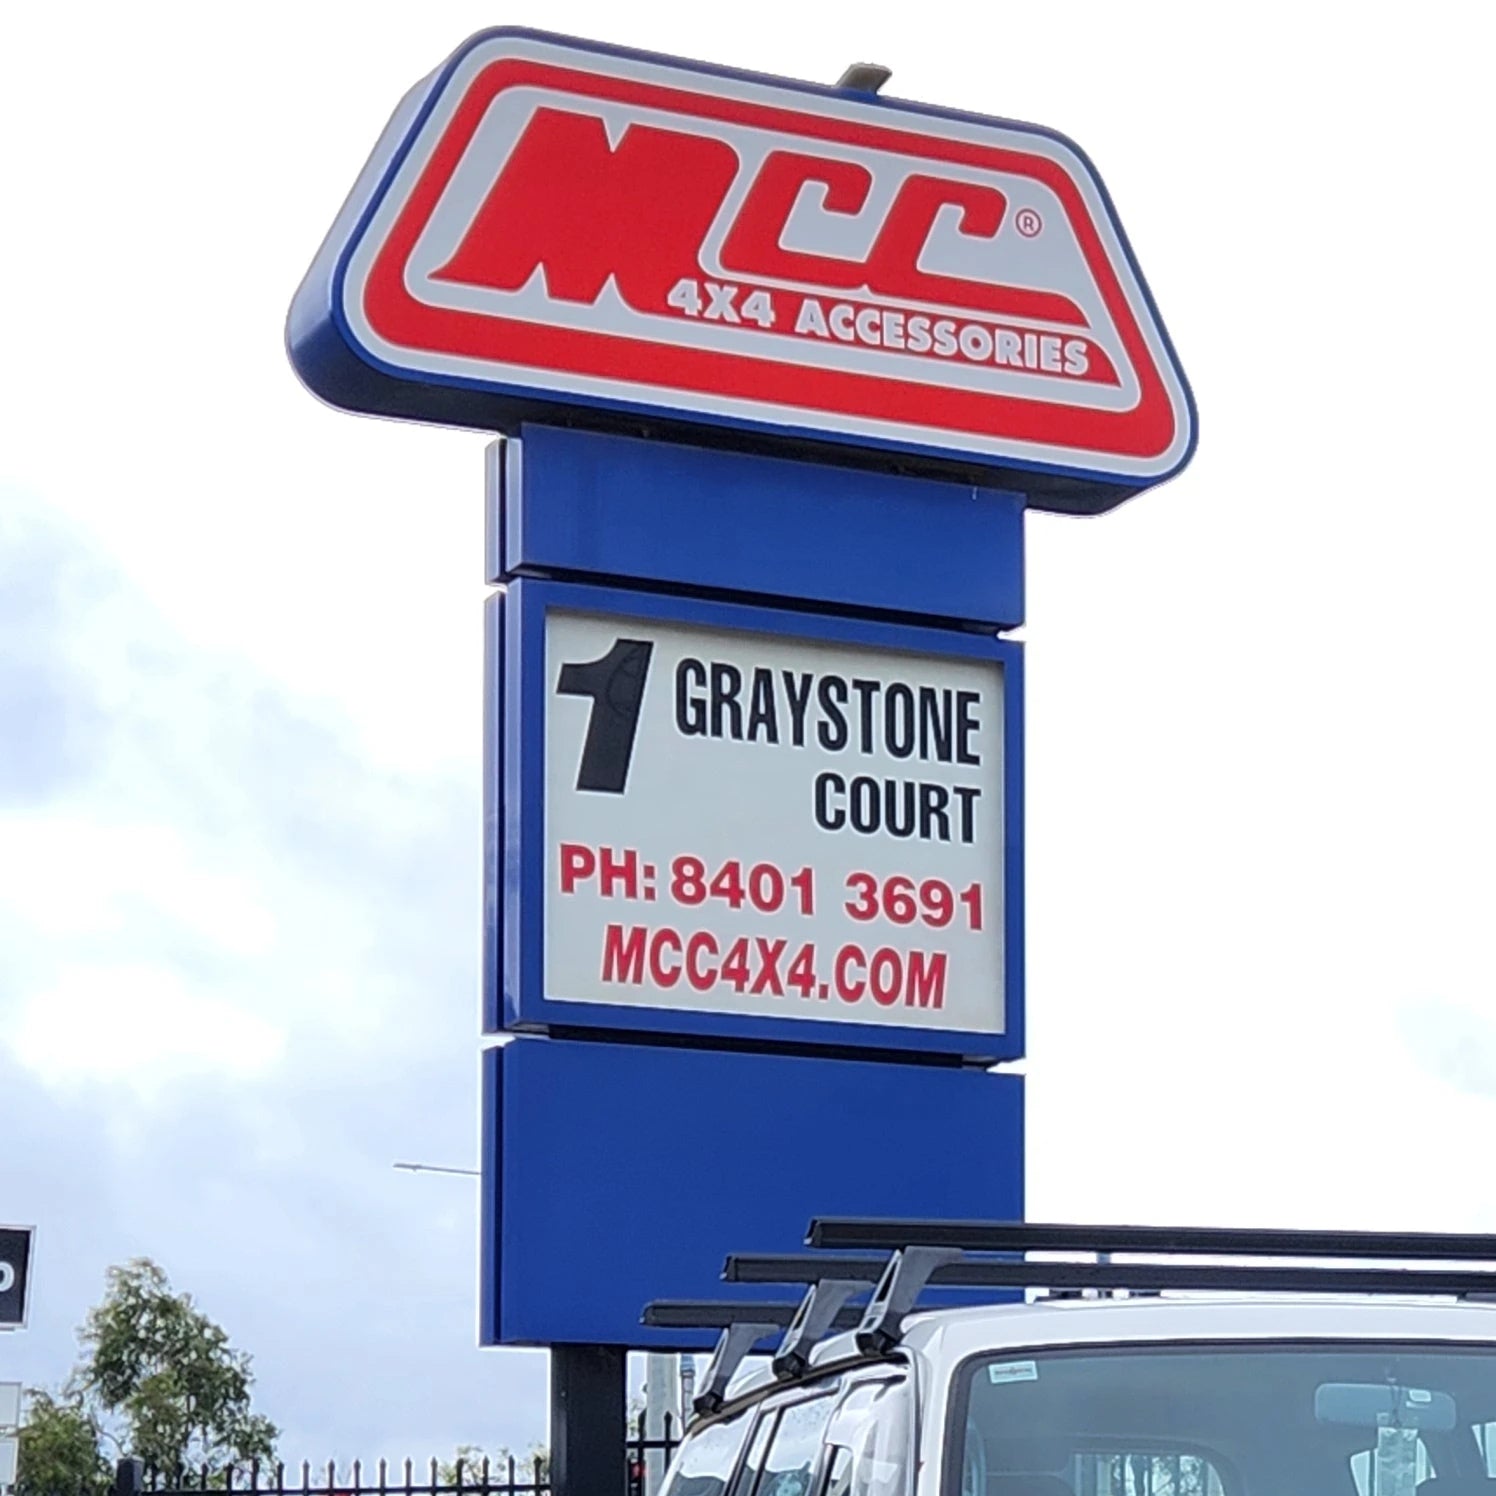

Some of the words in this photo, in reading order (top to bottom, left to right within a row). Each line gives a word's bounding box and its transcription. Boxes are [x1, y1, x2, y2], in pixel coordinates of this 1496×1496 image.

[427, 106, 1090, 328] MCC
[667, 279, 776, 329] 4X4
[796, 300, 1090, 377] ACCESSORIES
[556, 638, 654, 795] 1
[675, 658, 981, 766] GRAYSTONE
[814, 772, 981, 844] COURT
[559, 843, 656, 900] PH:
[670, 856, 815, 916] 8401
[844, 872, 984, 931] 3691
[602, 924, 948, 1009] MCC4X4.COM
